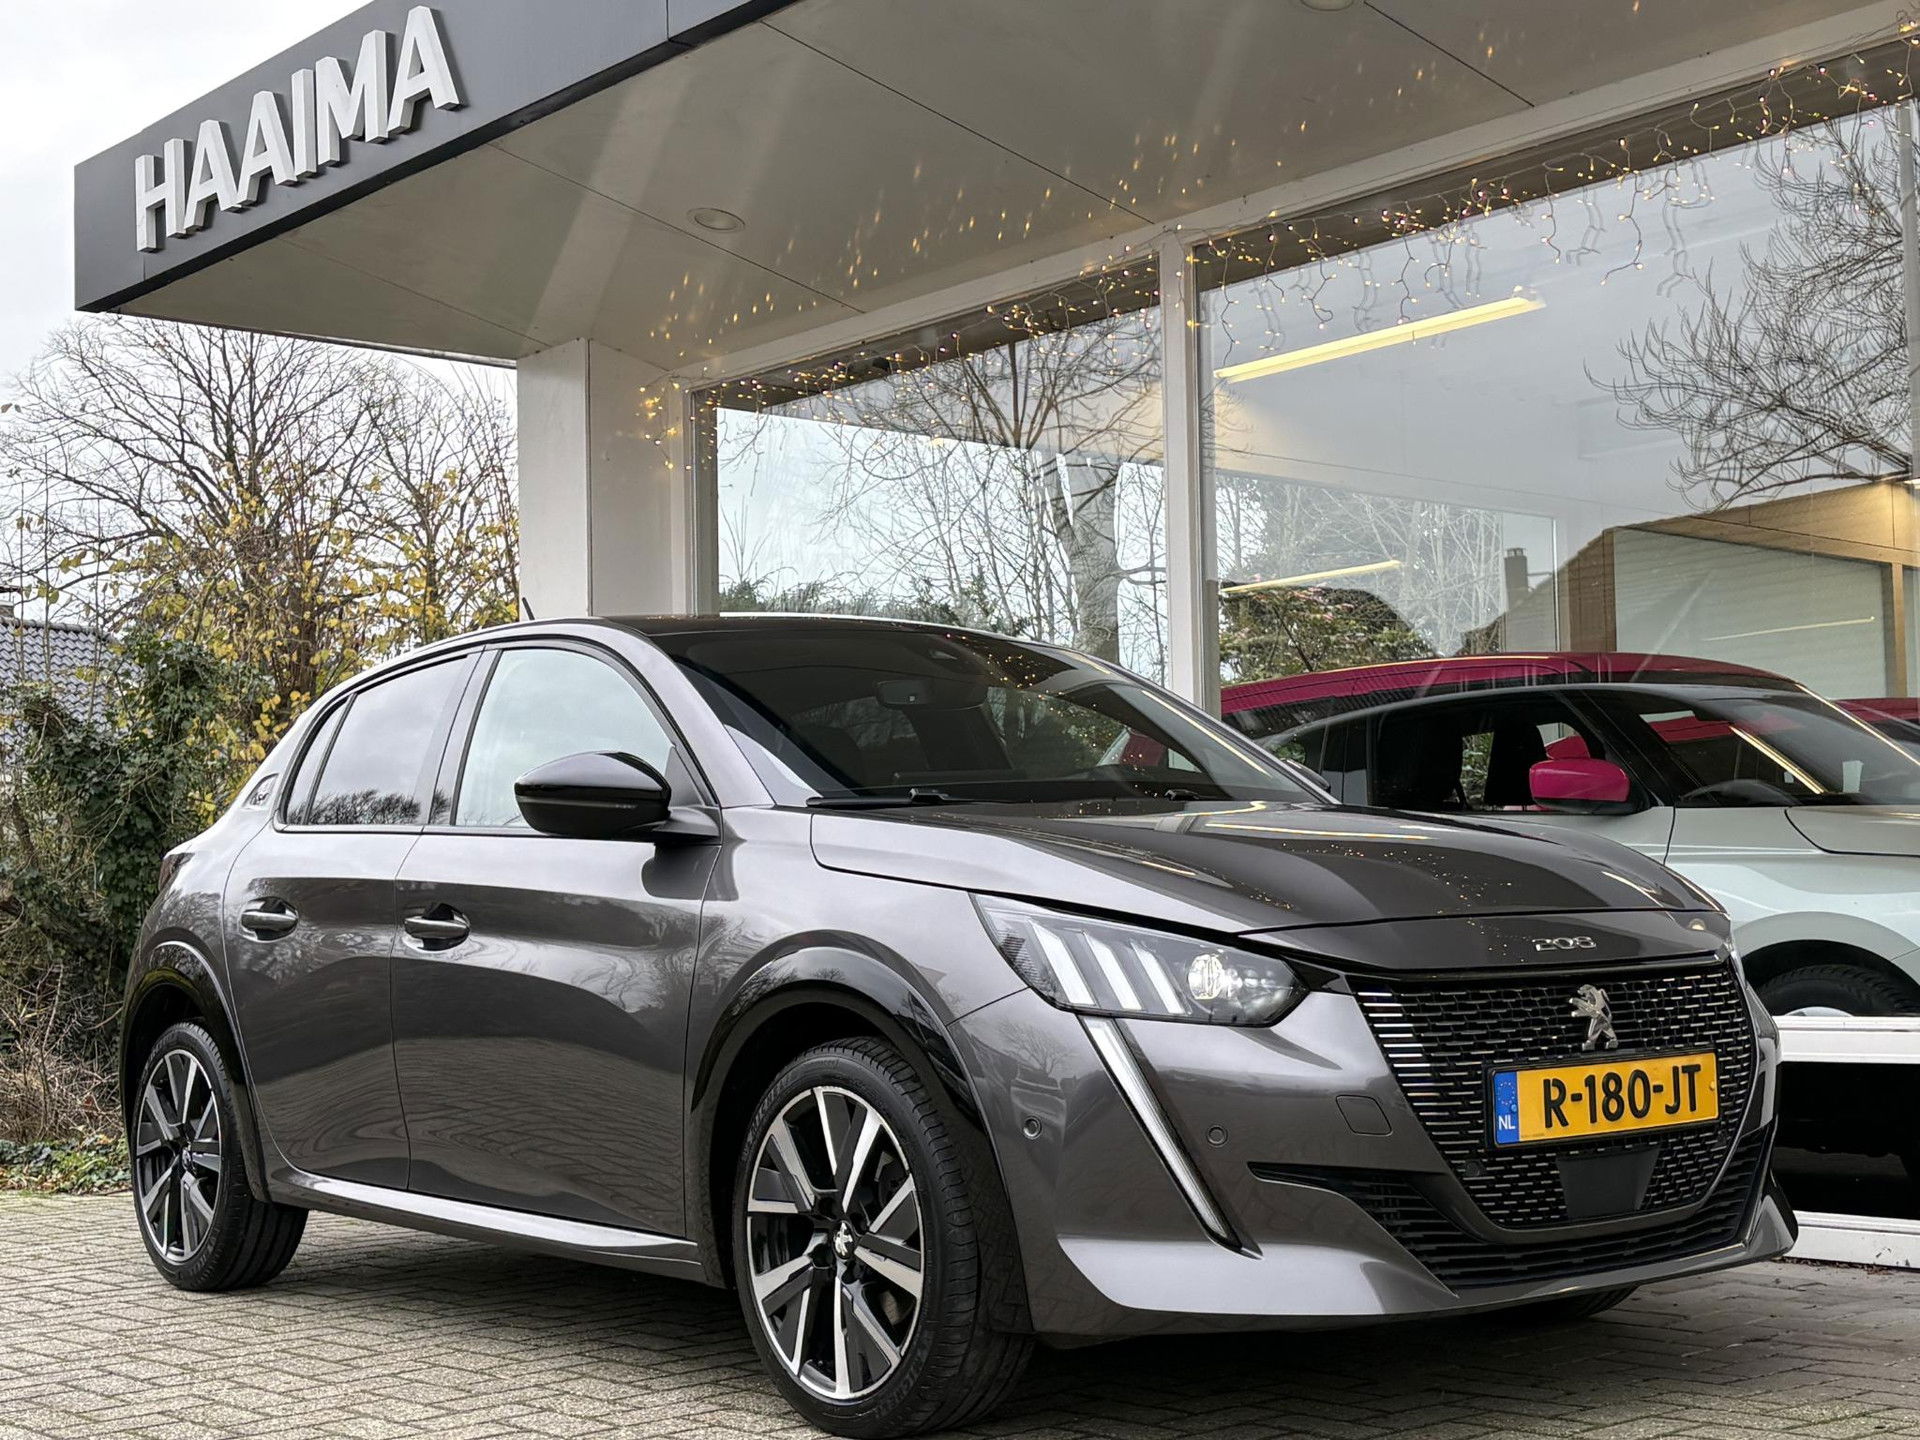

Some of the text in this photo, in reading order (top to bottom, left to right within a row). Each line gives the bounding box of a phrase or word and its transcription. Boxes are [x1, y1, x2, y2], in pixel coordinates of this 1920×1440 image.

[135, 5, 461, 253] HAAIMA
[1532, 936, 1597, 951] 208
[1542, 1064, 1701, 1128] R-180-JT
[1498, 1115, 1516, 1130] NL
